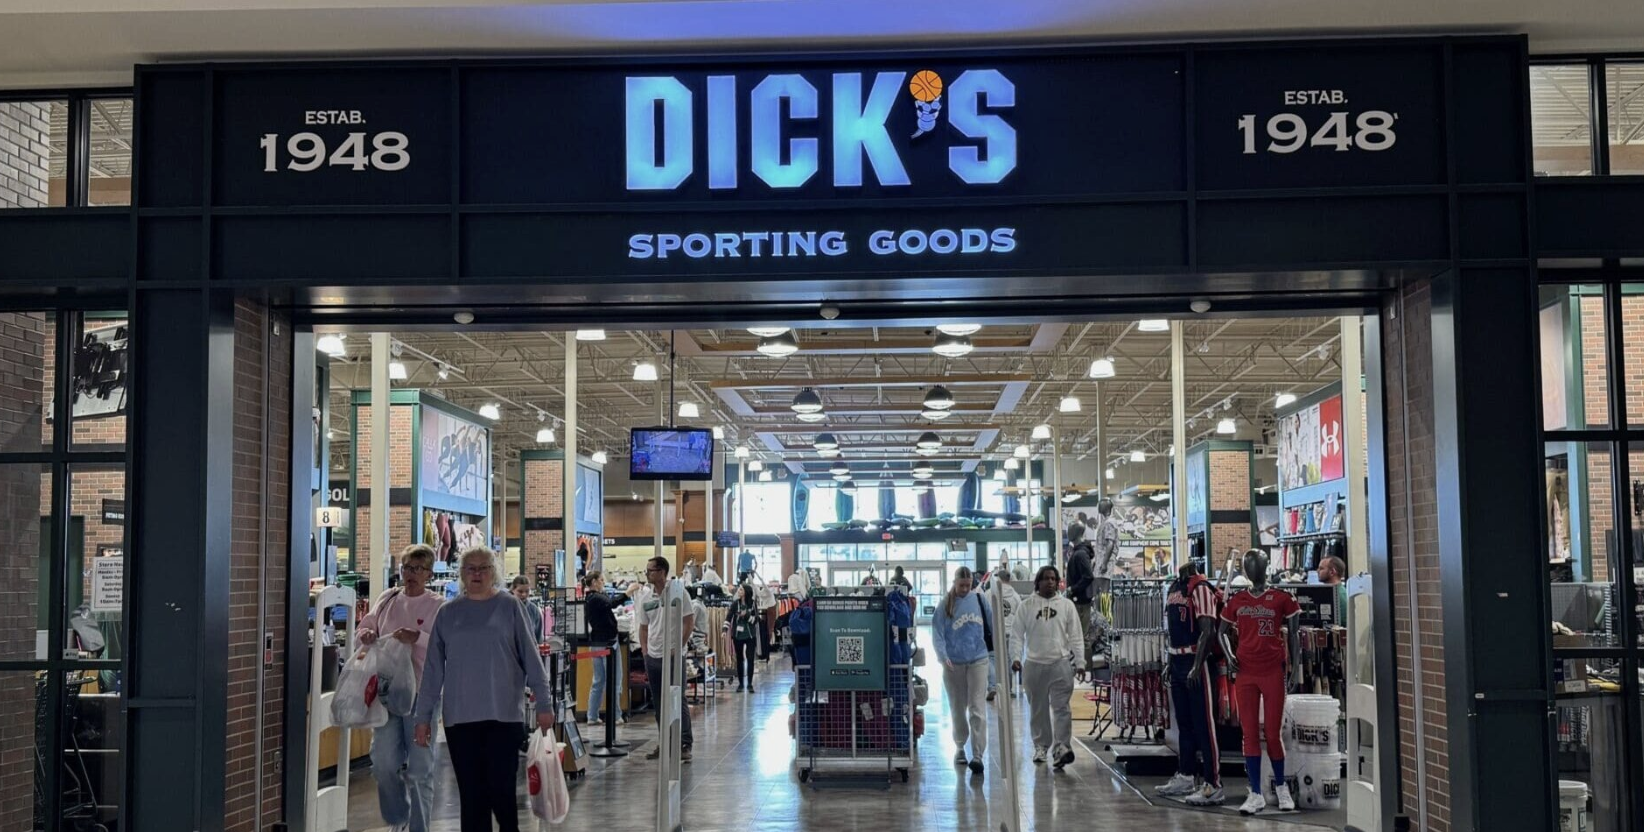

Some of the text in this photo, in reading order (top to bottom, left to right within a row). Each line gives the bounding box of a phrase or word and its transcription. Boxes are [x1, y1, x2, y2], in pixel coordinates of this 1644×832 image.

[1284, 90, 1349, 105] ESTAB.
[305, 111, 366, 125] ESTAB.
[626, 69, 1016, 189] DICK'S
[261, 131, 411, 172] 1948
[628, 227, 1016, 259] SPORTING GOODS
[322, 511, 330, 523] 8
